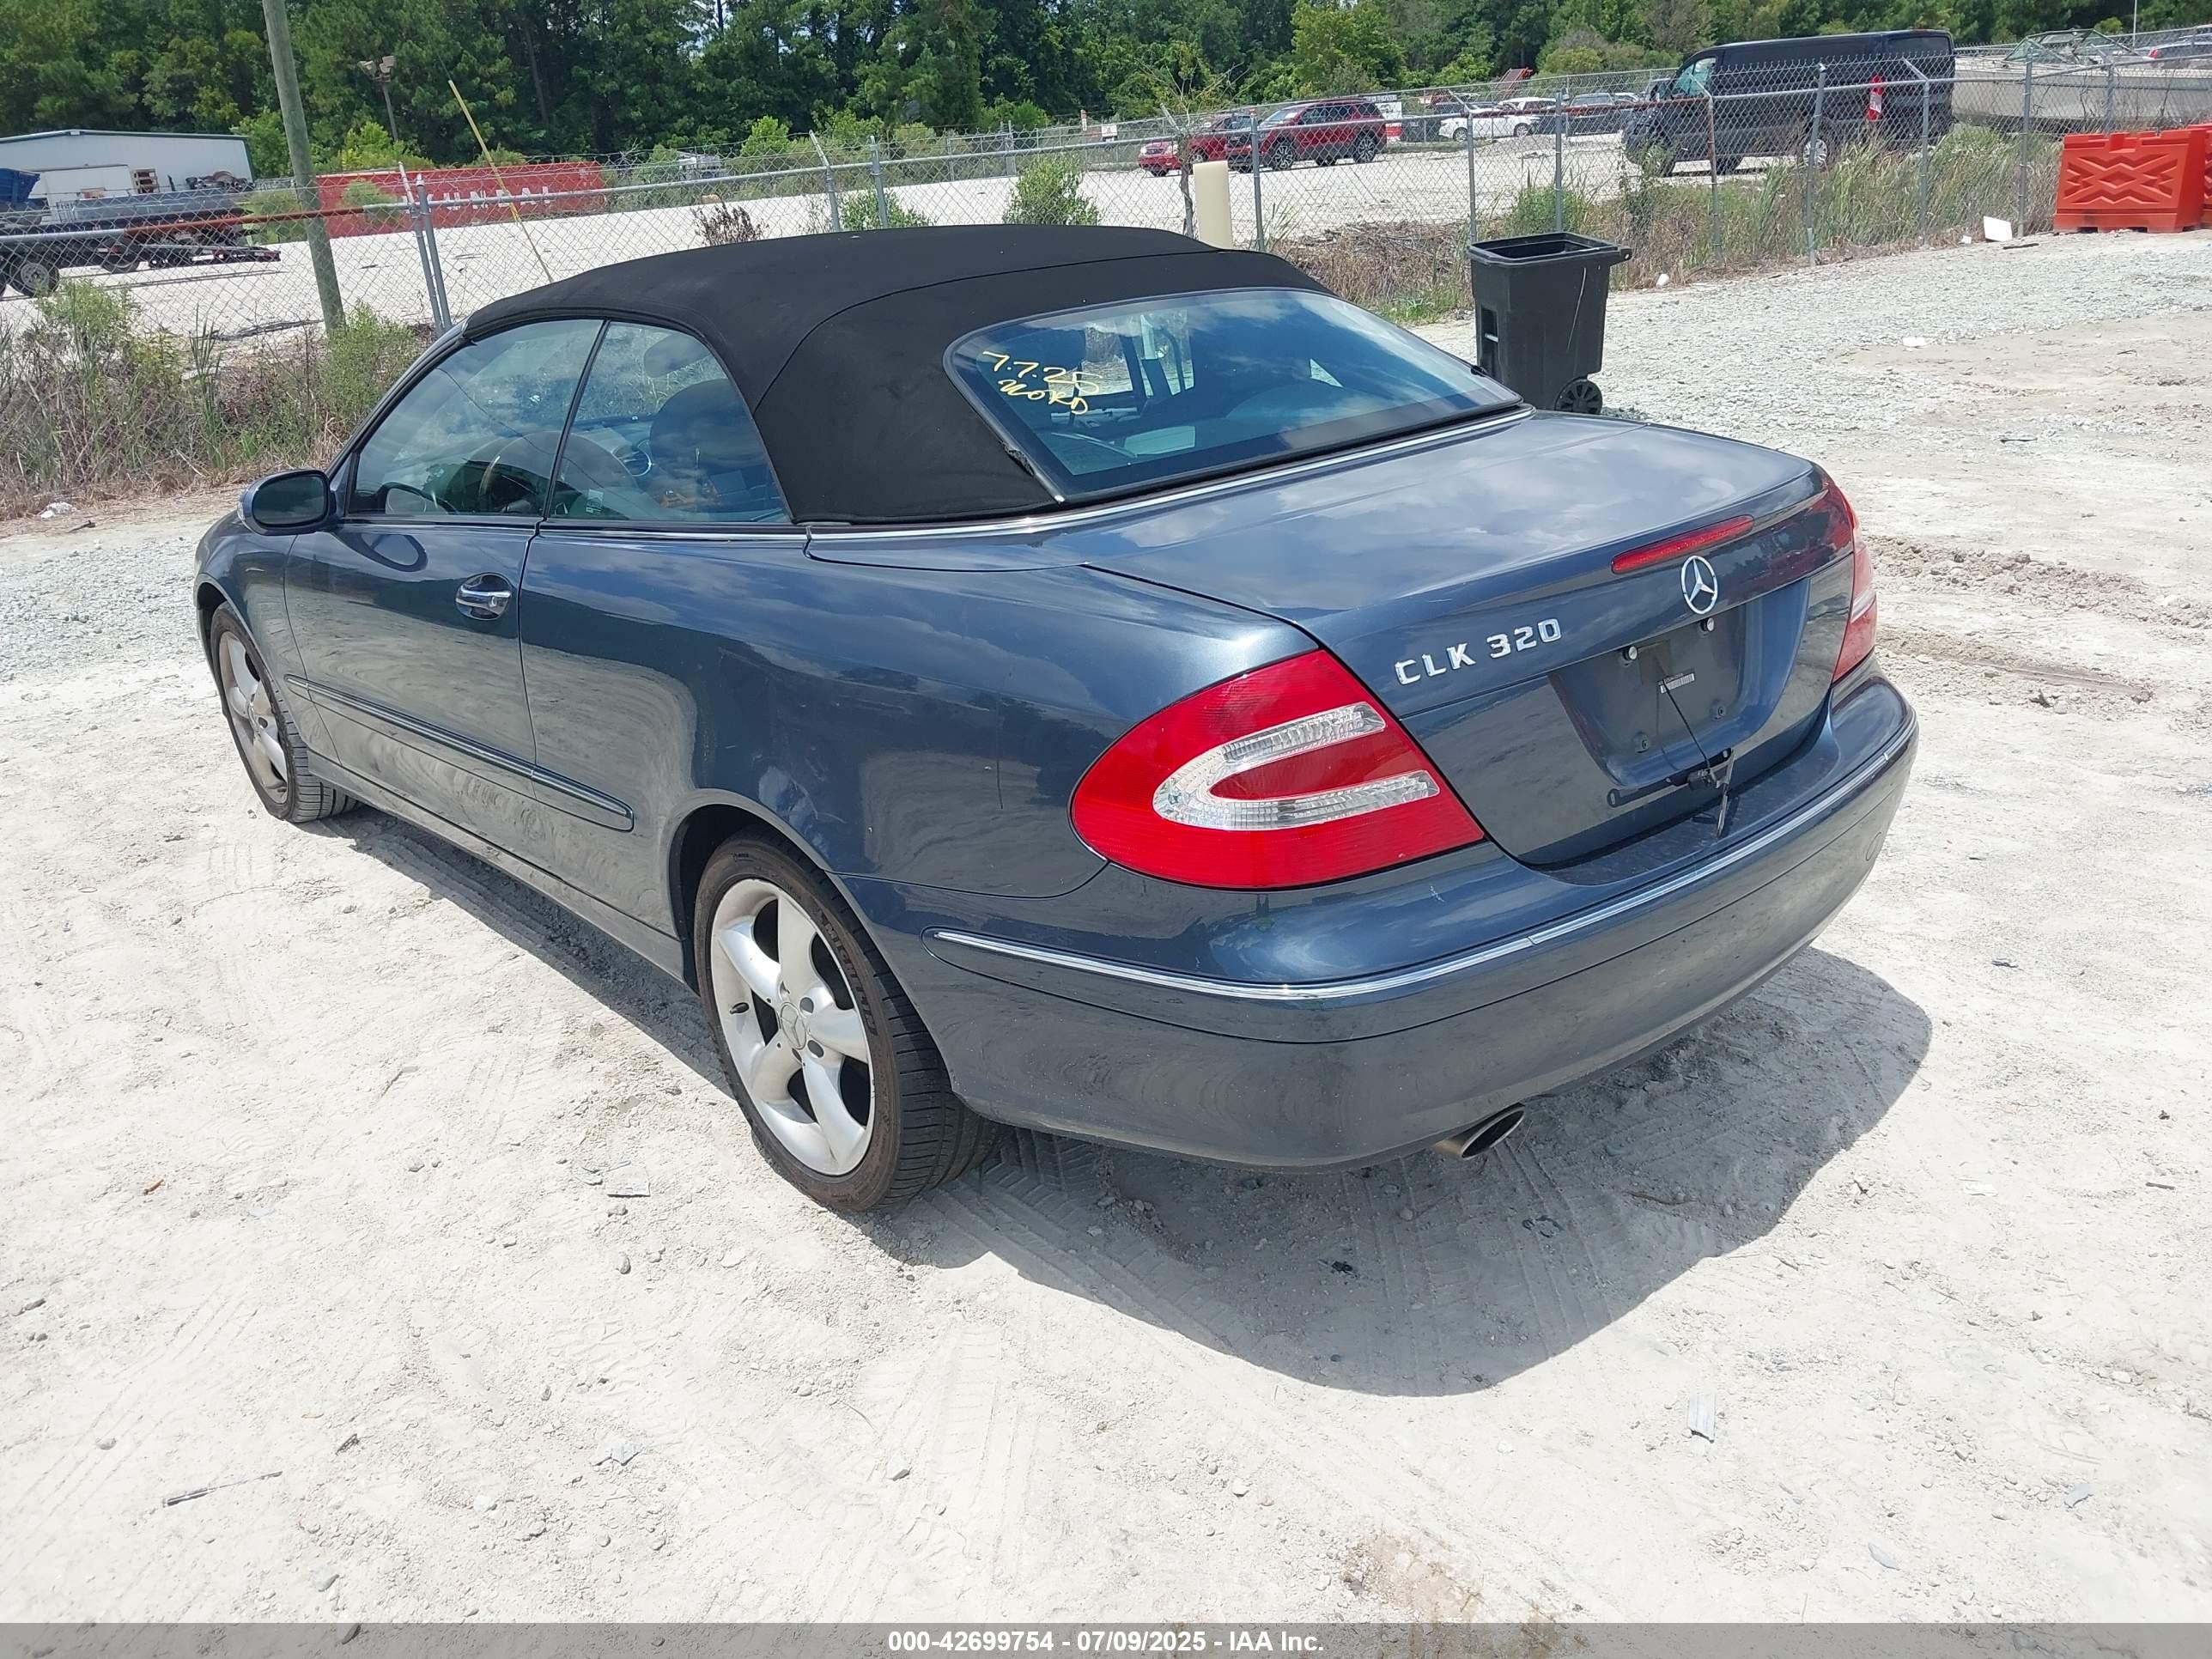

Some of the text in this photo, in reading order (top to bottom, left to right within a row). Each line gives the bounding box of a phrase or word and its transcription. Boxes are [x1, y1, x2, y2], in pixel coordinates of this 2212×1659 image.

[981, 350, 1104, 395] 7.7.25
[1395, 617, 1562, 685] CLK 320
